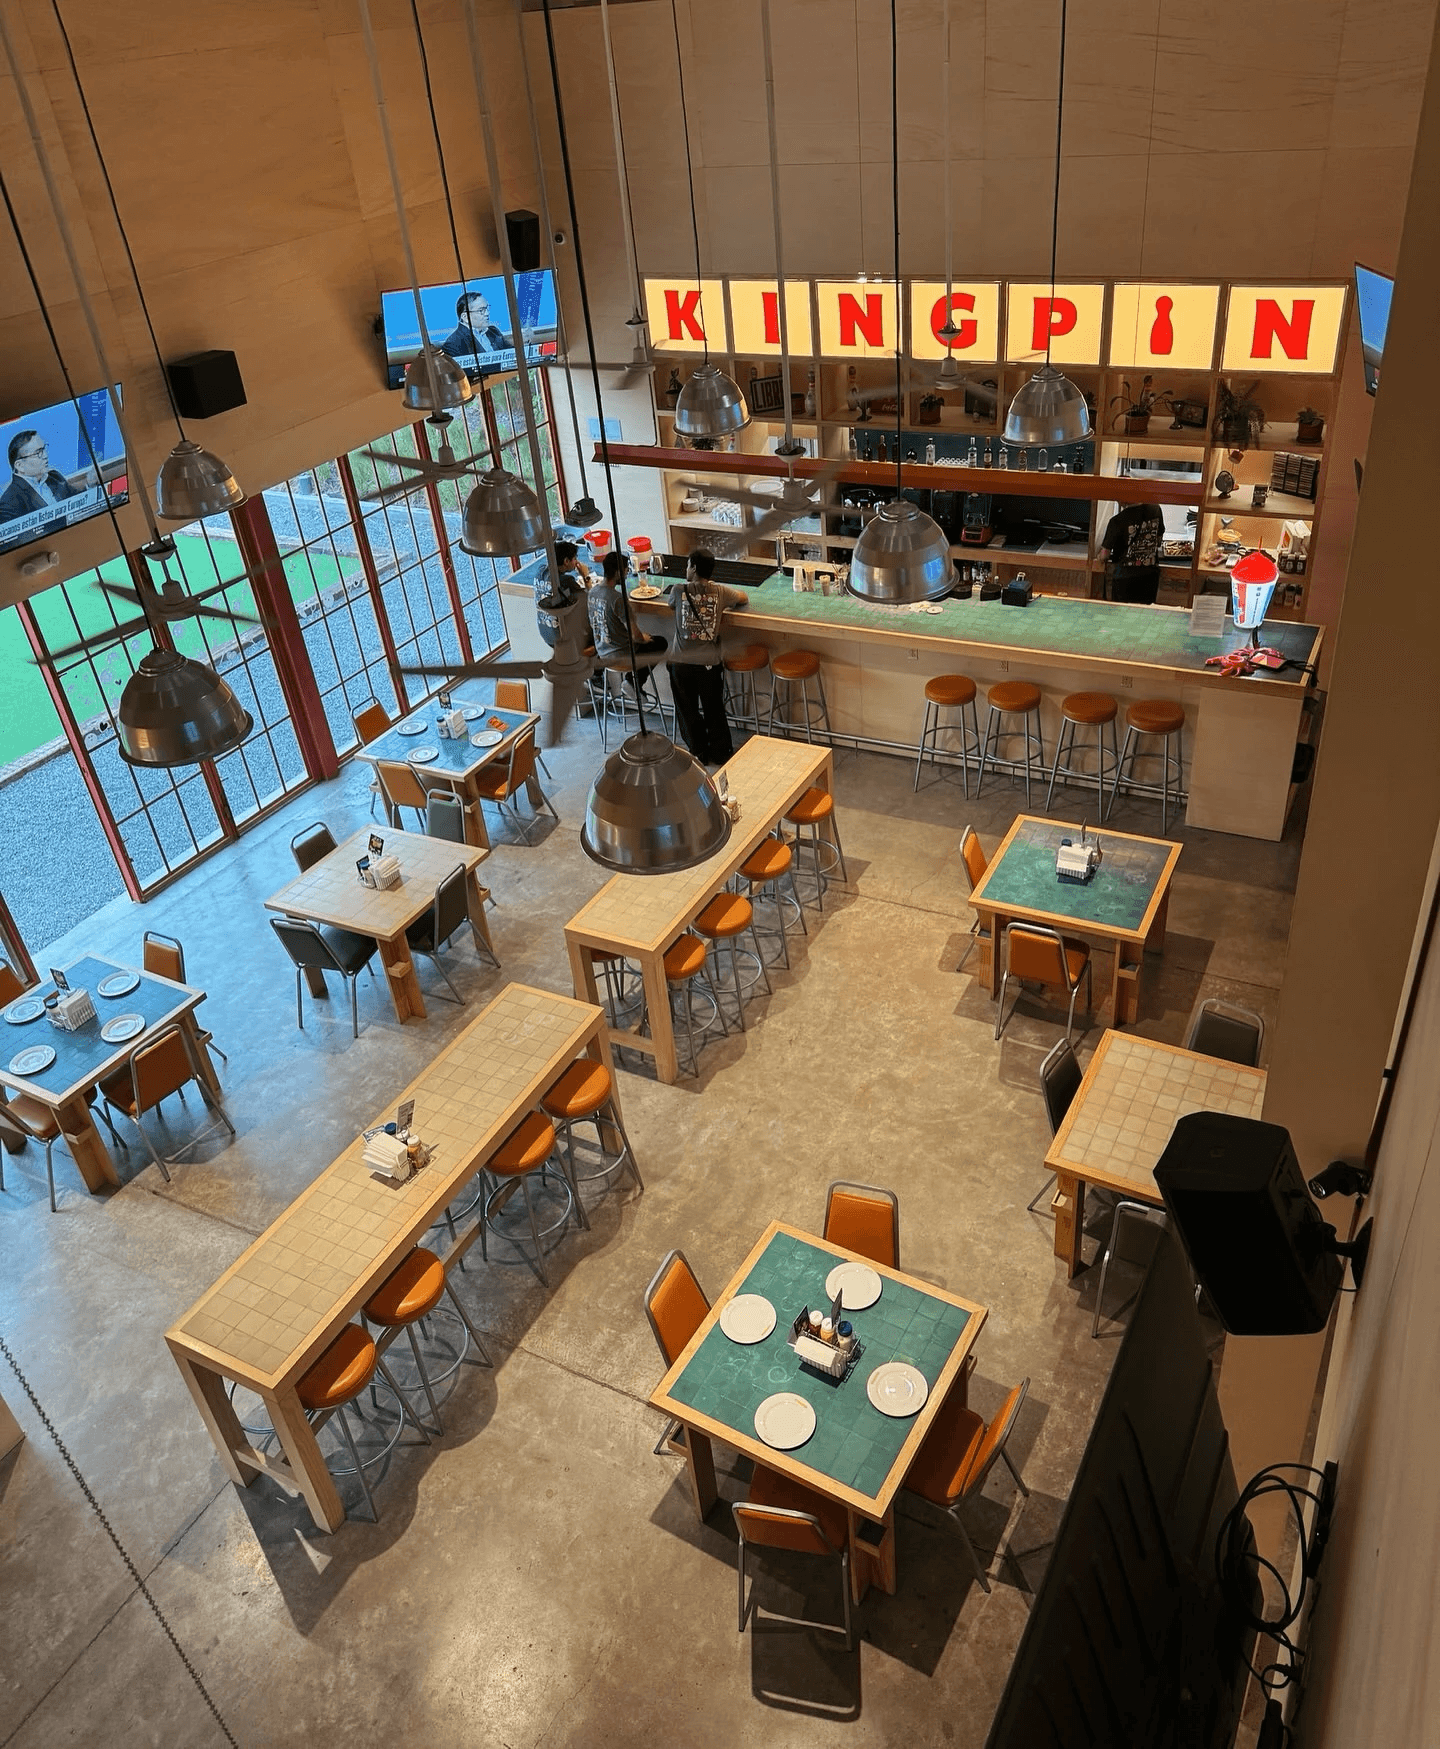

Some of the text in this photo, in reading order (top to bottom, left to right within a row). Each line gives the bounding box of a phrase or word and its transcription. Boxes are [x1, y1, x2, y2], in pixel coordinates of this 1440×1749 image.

[21, 516, 38, 530] están
[54, 504, 67, 518] para
[67, 493, 89, 512] Europa?
